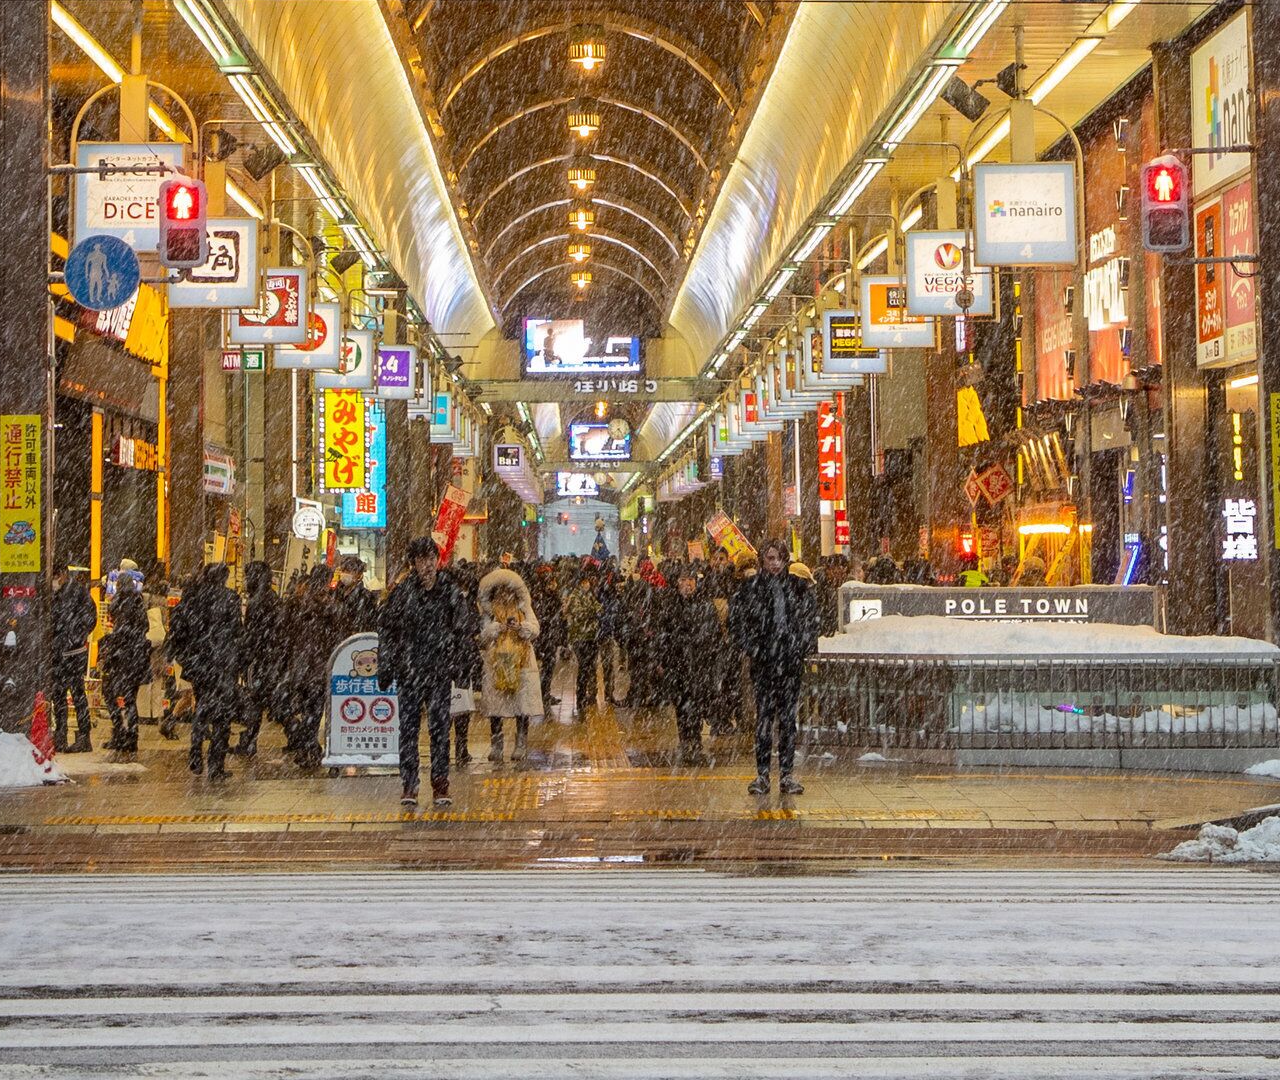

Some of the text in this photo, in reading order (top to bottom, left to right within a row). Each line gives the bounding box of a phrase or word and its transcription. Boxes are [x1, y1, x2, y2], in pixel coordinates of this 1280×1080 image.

[104, 202, 155, 219] DiCE
[1009, 203, 1063, 217] nanairo
[122, 229, 137, 246] 4
[1020, 243, 1034, 259] 4
[205, 288, 218, 303] 4
[222, 353, 241, 368] ATM
[246, 353, 260, 368] 酒
[330, 388, 361, 485] みやげ
[820, 411, 842, 478] メガネ
[3, 423, 23, 511] 通行禁止
[24, 423, 37, 509] 許可車両以外
[498, 456, 519, 466] Bar
[1222, 498, 1258, 560] 皆様
[945, 599, 1088, 615] POLE TOWN
